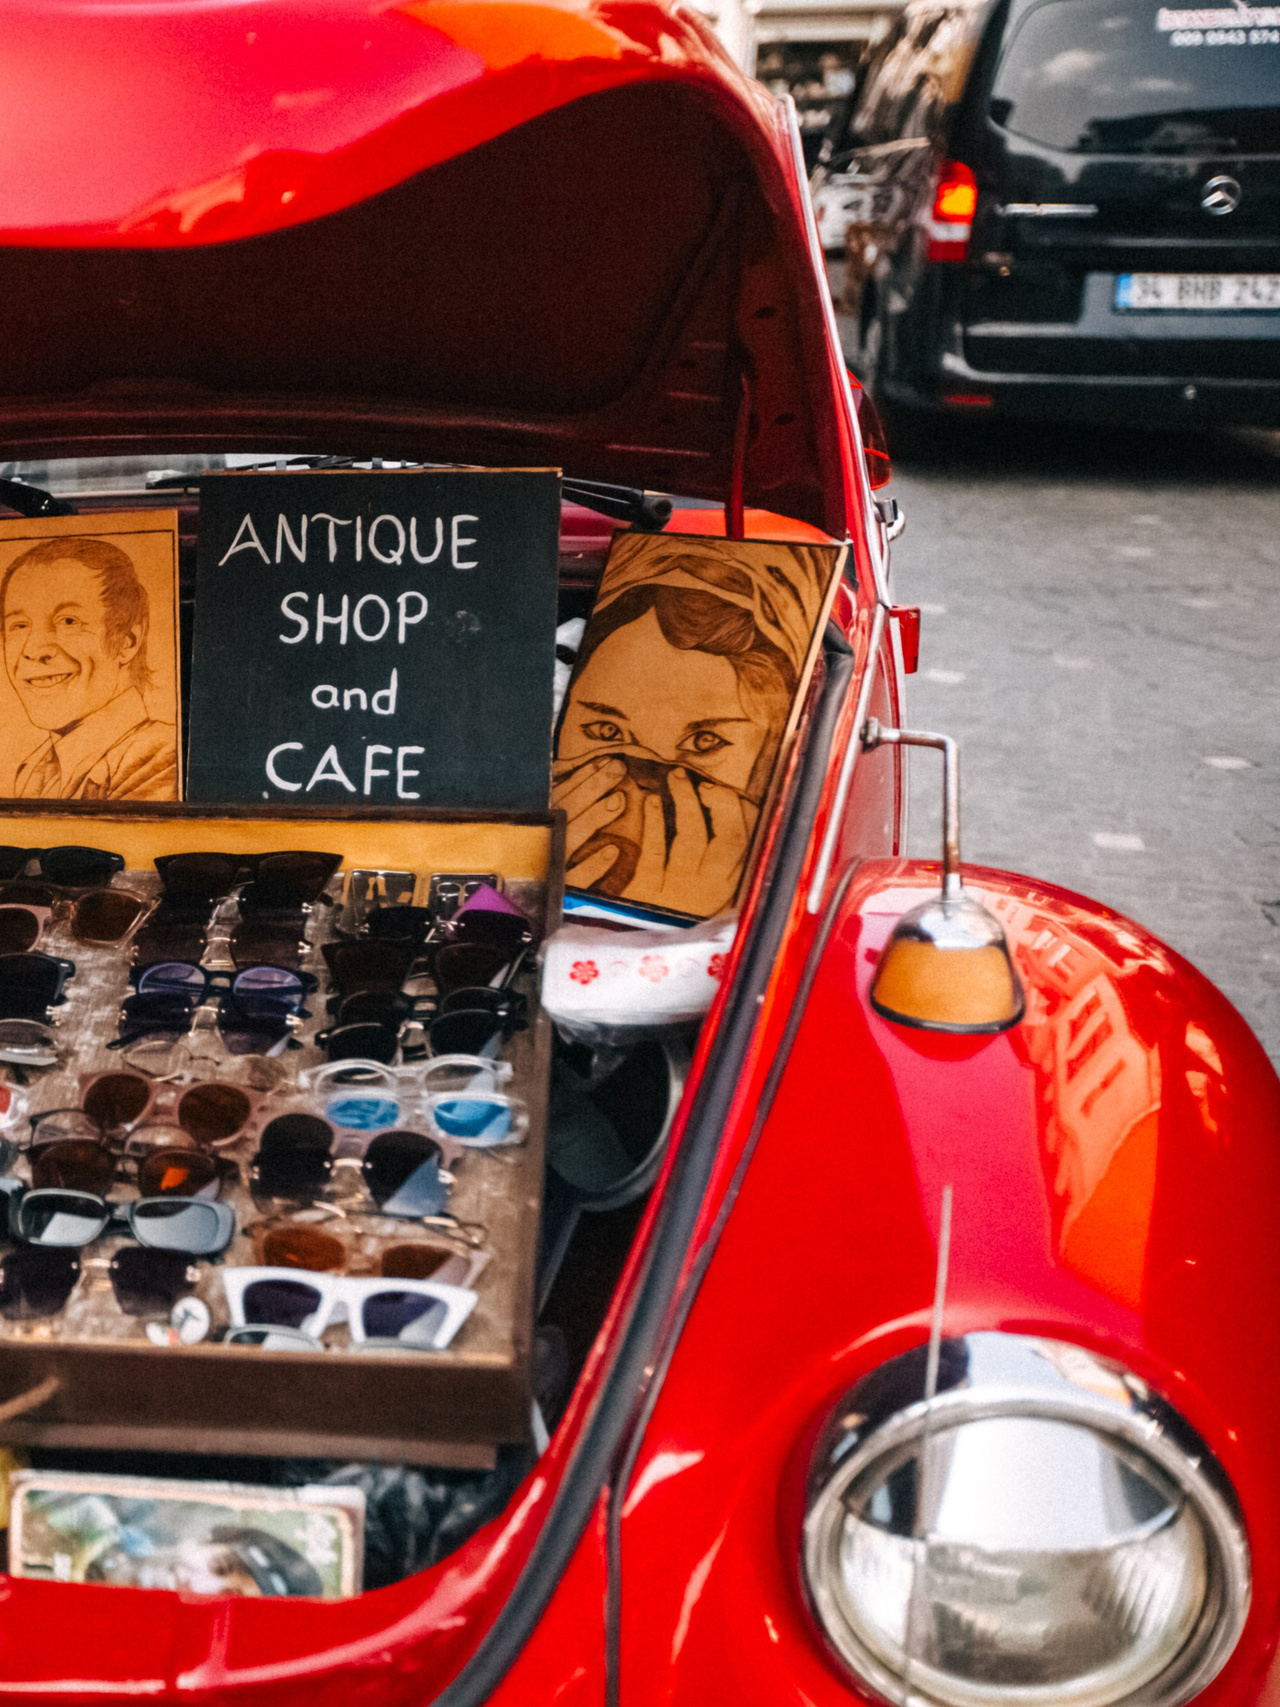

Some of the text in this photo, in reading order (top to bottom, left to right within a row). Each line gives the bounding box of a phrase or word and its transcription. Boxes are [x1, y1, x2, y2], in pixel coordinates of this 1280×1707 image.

[218, 513, 479, 569] ANTIQUE
[279, 591, 428, 645] SHOP
[311, 667, 399, 716] and
[265, 741, 426, 799] CAFE
